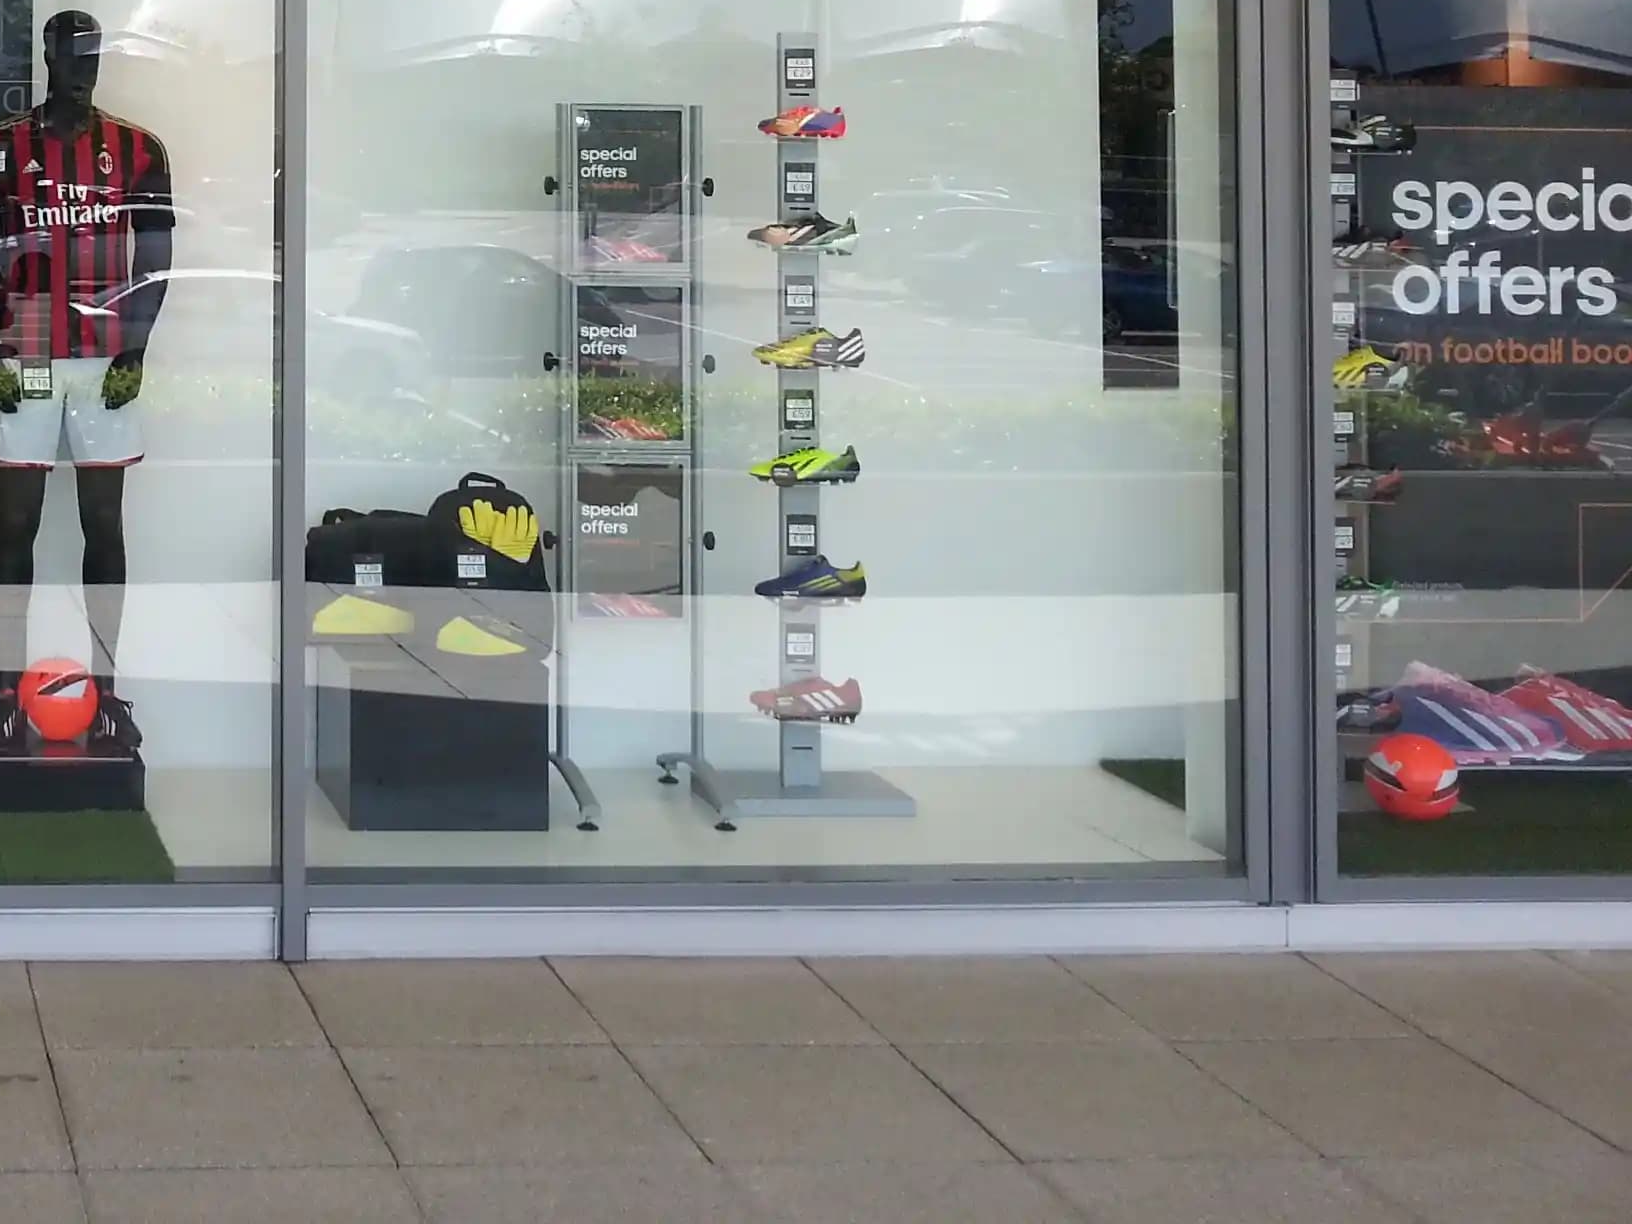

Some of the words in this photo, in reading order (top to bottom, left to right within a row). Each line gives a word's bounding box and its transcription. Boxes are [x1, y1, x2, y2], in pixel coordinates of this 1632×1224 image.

[580, 146, 637, 164] special
[580, 164, 628, 178] offers
[56, 183, 88, 202] Fly
[1392, 249, 1617, 316] offers
[580, 323, 637, 340] special
[580, 340, 628, 355] offers
[1442, 336, 1564, 365] football
[581, 501, 638, 519] special
[581, 519, 628, 534] offers
